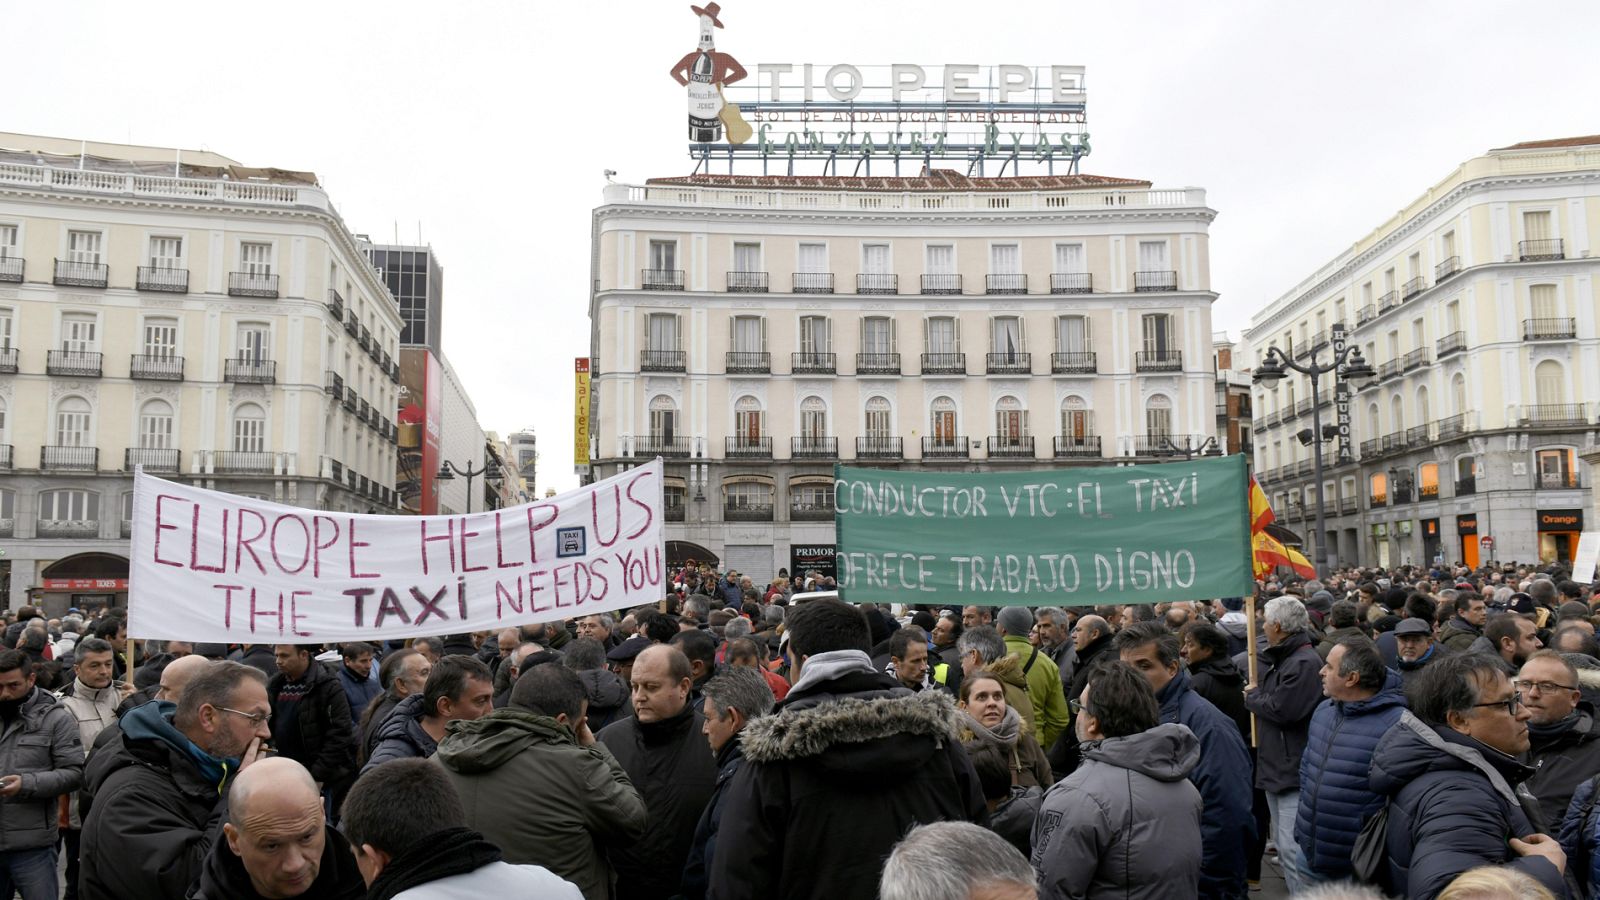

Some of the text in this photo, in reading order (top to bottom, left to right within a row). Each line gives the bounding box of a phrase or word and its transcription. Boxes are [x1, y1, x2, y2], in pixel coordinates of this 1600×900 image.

[757, 63, 1087, 103] TIO PEPE
[754, 111, 793, 122] SOL
[801, 111, 823, 122] DE
[758, 123, 1092, 156] GONZALEZ BYASS
[1338, 391, 1351, 457] EUROPA
[834, 478, 988, 518] CONDUCTOR
[154, 471, 653, 579] EUROPE HELP US
[1542, 515, 1577, 525] Orange
[796, 548, 834, 556] PRIMOR
[213, 585, 313, 637] THE
[495, 563, 608, 620] NEEDS
[615, 546, 660, 593] YOU
[836, 551, 938, 593] OFRECE
[949, 551, 1081, 594] TRABAJO
